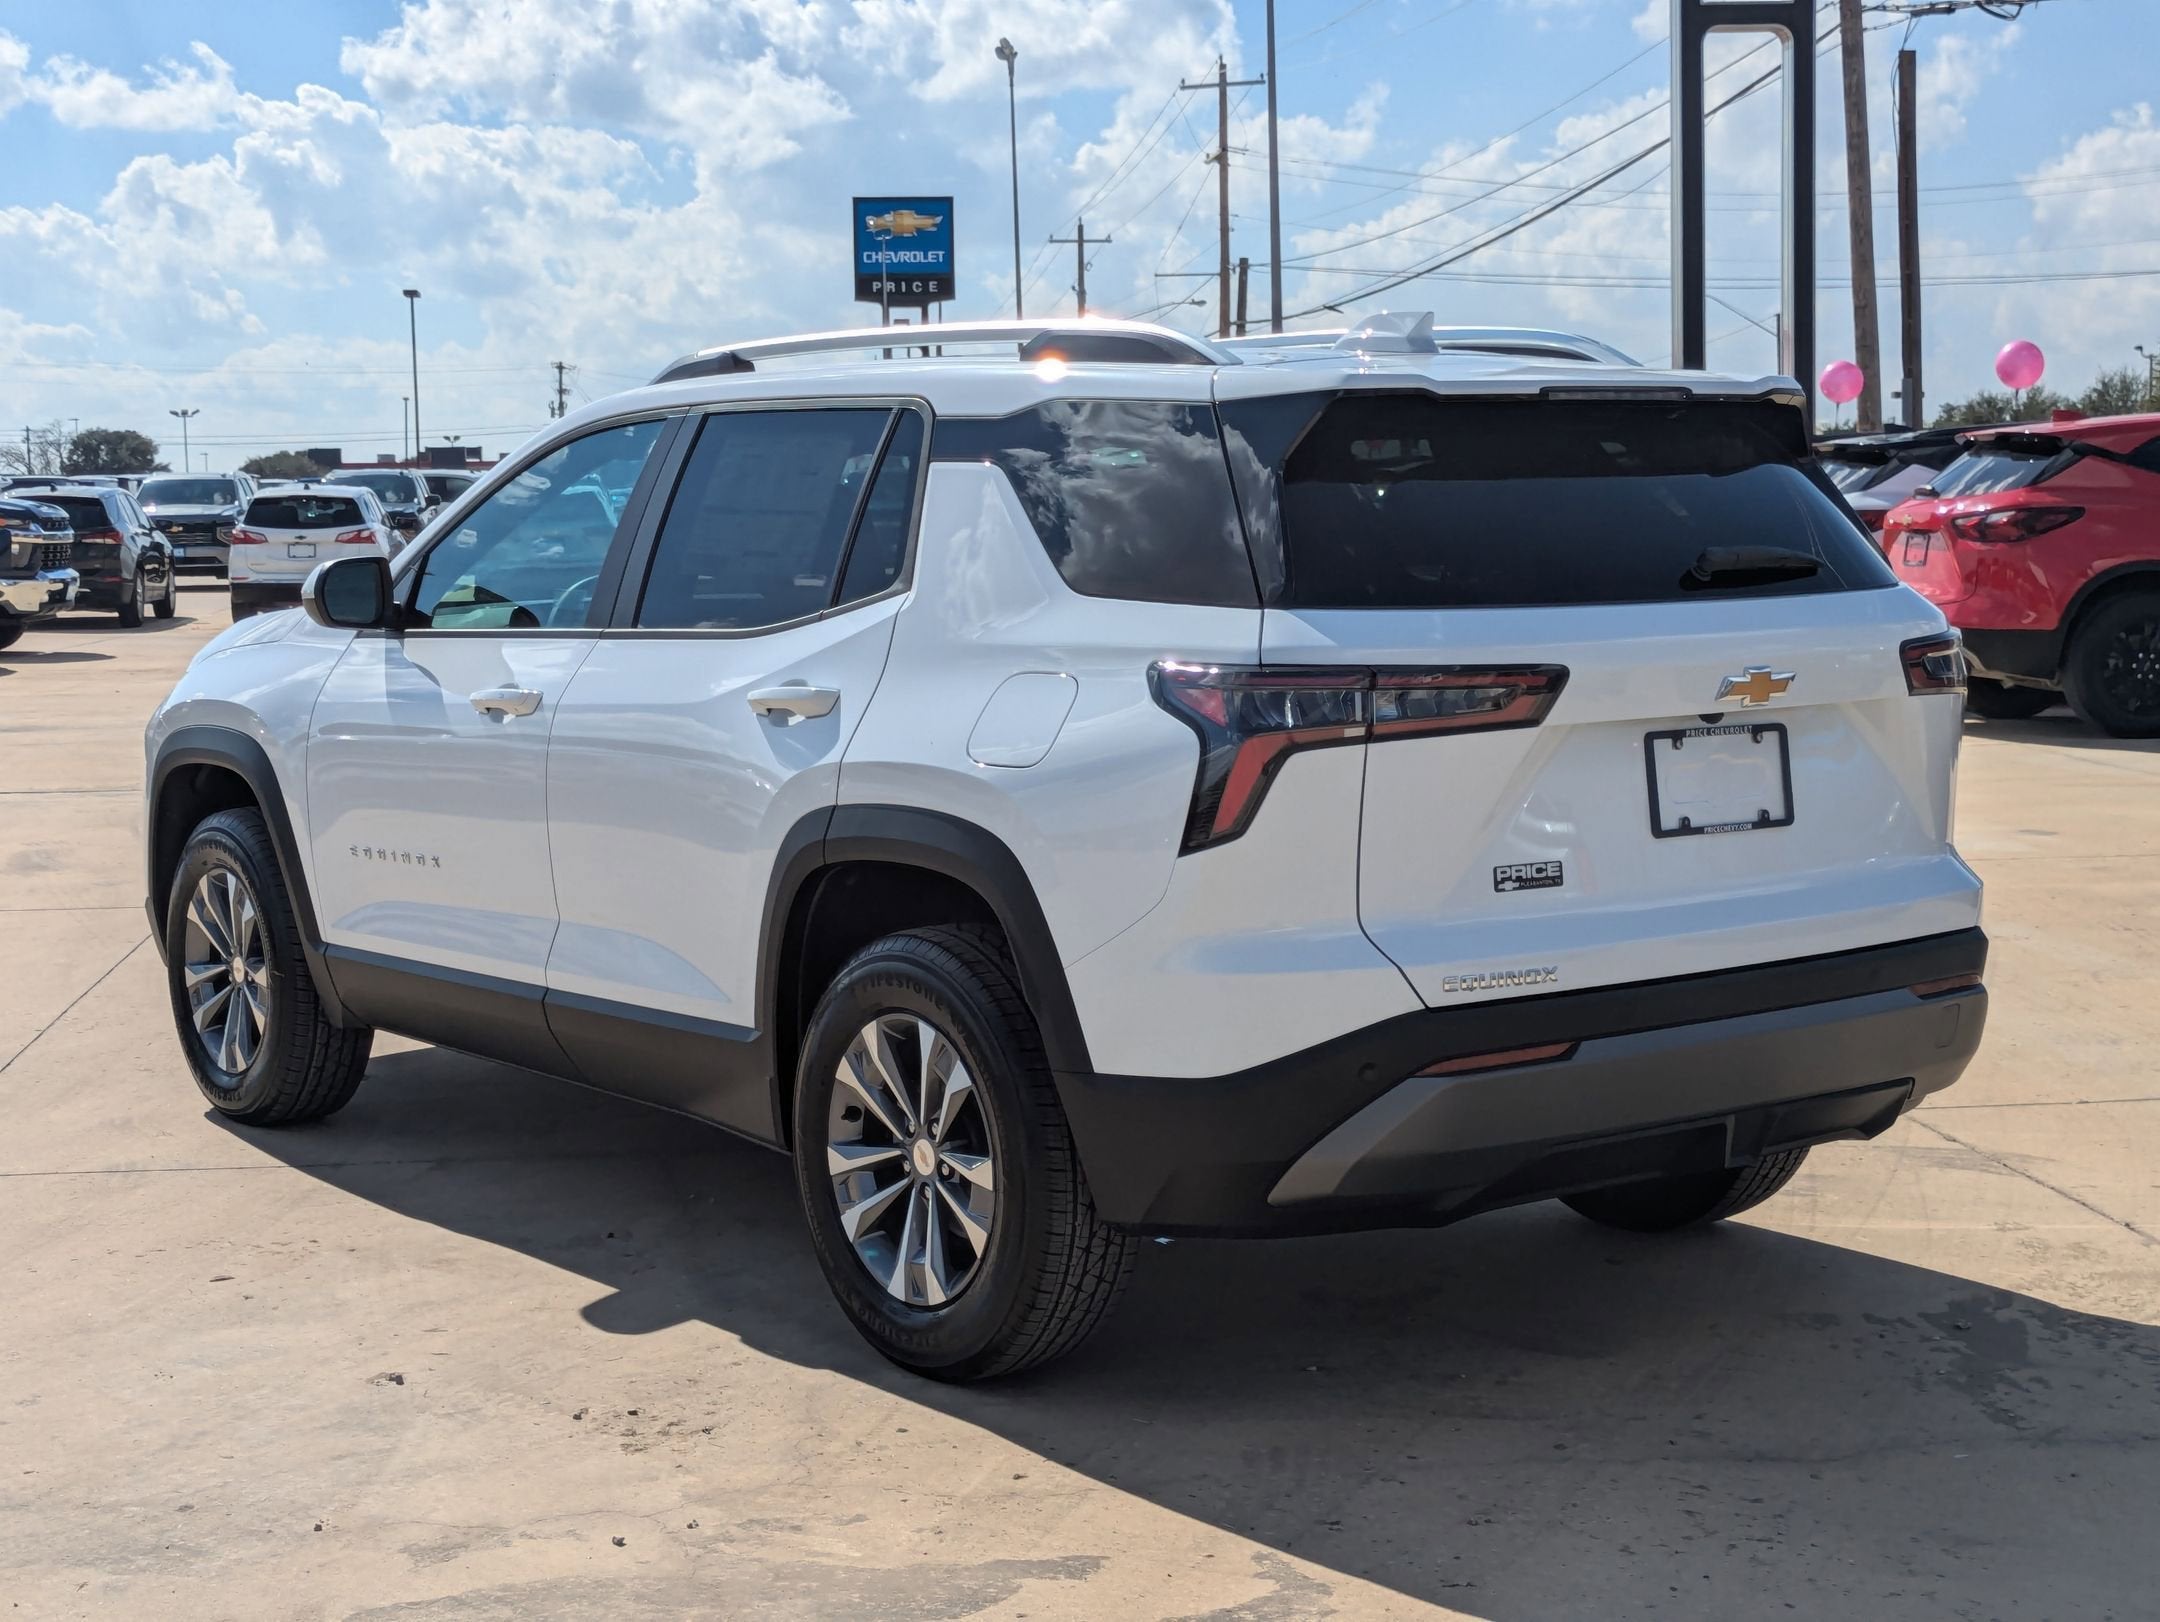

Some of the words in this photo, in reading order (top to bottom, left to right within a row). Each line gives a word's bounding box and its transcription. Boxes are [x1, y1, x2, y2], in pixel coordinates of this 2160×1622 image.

[863, 251, 945, 263] CHEVROLET
[872, 281, 938, 293] PRICE
[1685, 728, 1708, 737] PRICE
[1710, 725, 1753, 736] CHEVROLET
[349, 844, 441, 869] EQUINOX
[1496, 862, 1561, 882] PRICE
[1442, 965, 1559, 993] EQUINOX
